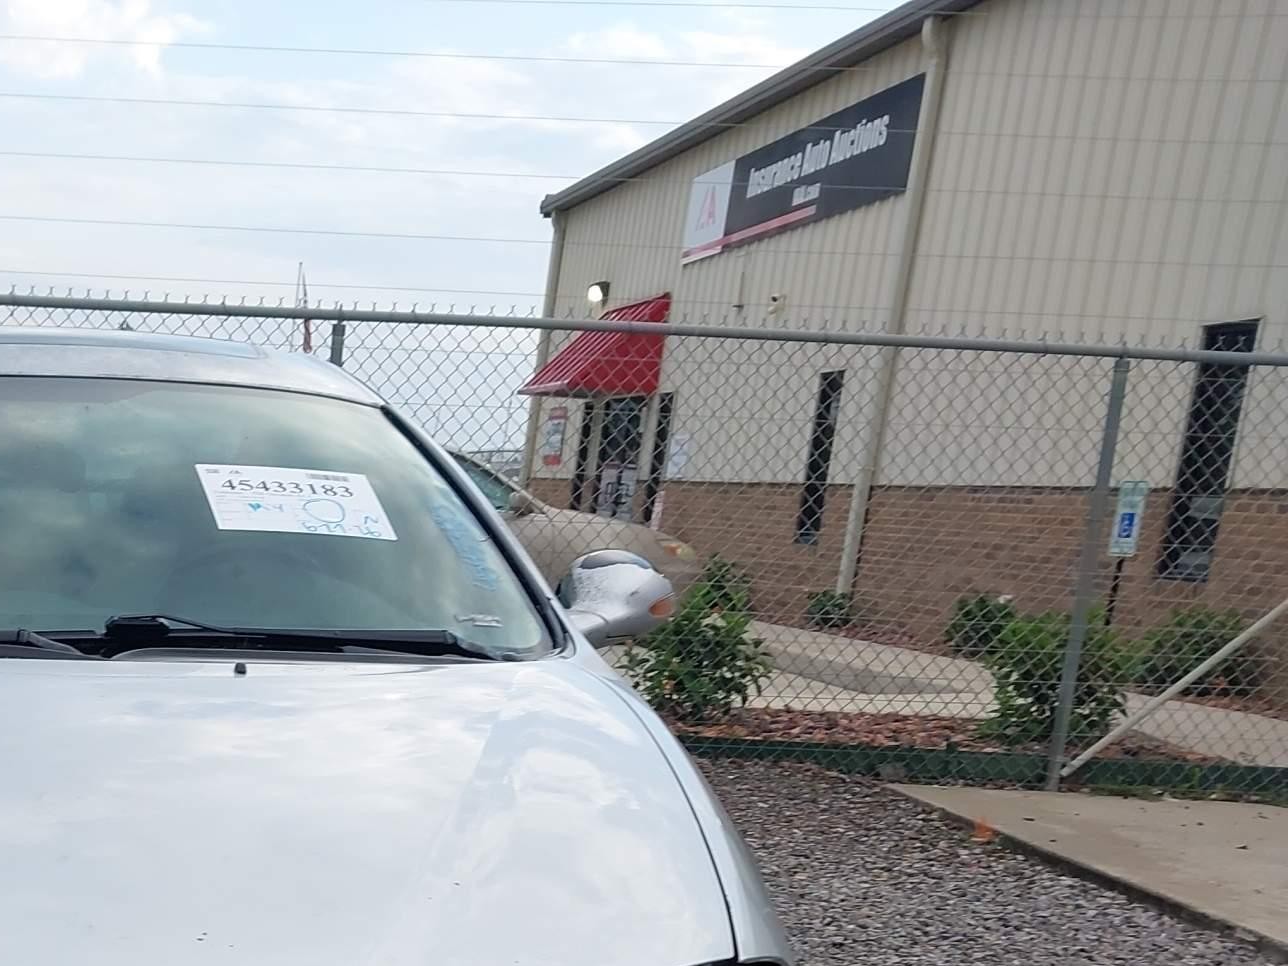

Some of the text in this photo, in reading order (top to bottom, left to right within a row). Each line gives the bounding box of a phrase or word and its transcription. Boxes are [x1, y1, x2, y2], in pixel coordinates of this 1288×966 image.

[746, 151, 803, 199] Insurance
[801, 139, 831, 177] Auto
[829, 114, 890, 166] Auctions
[221, 477, 355, 498] 45433183
